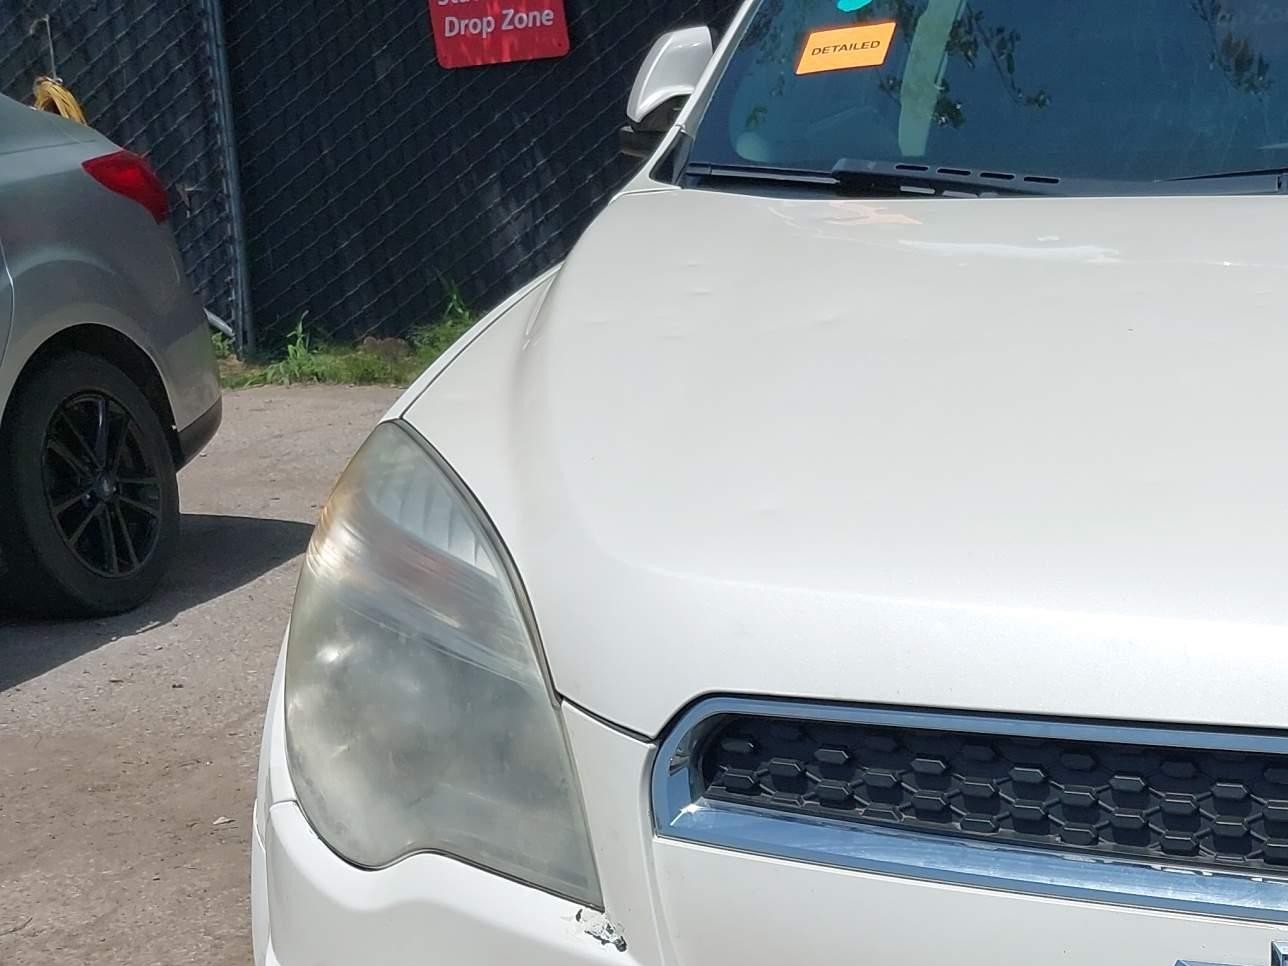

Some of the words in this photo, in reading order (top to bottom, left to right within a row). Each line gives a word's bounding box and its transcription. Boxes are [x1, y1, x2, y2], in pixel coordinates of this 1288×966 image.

[444, 16, 496, 39] Drop
[501, 9, 555, 31] Zone
[811, 40, 881, 56] DETAILED
